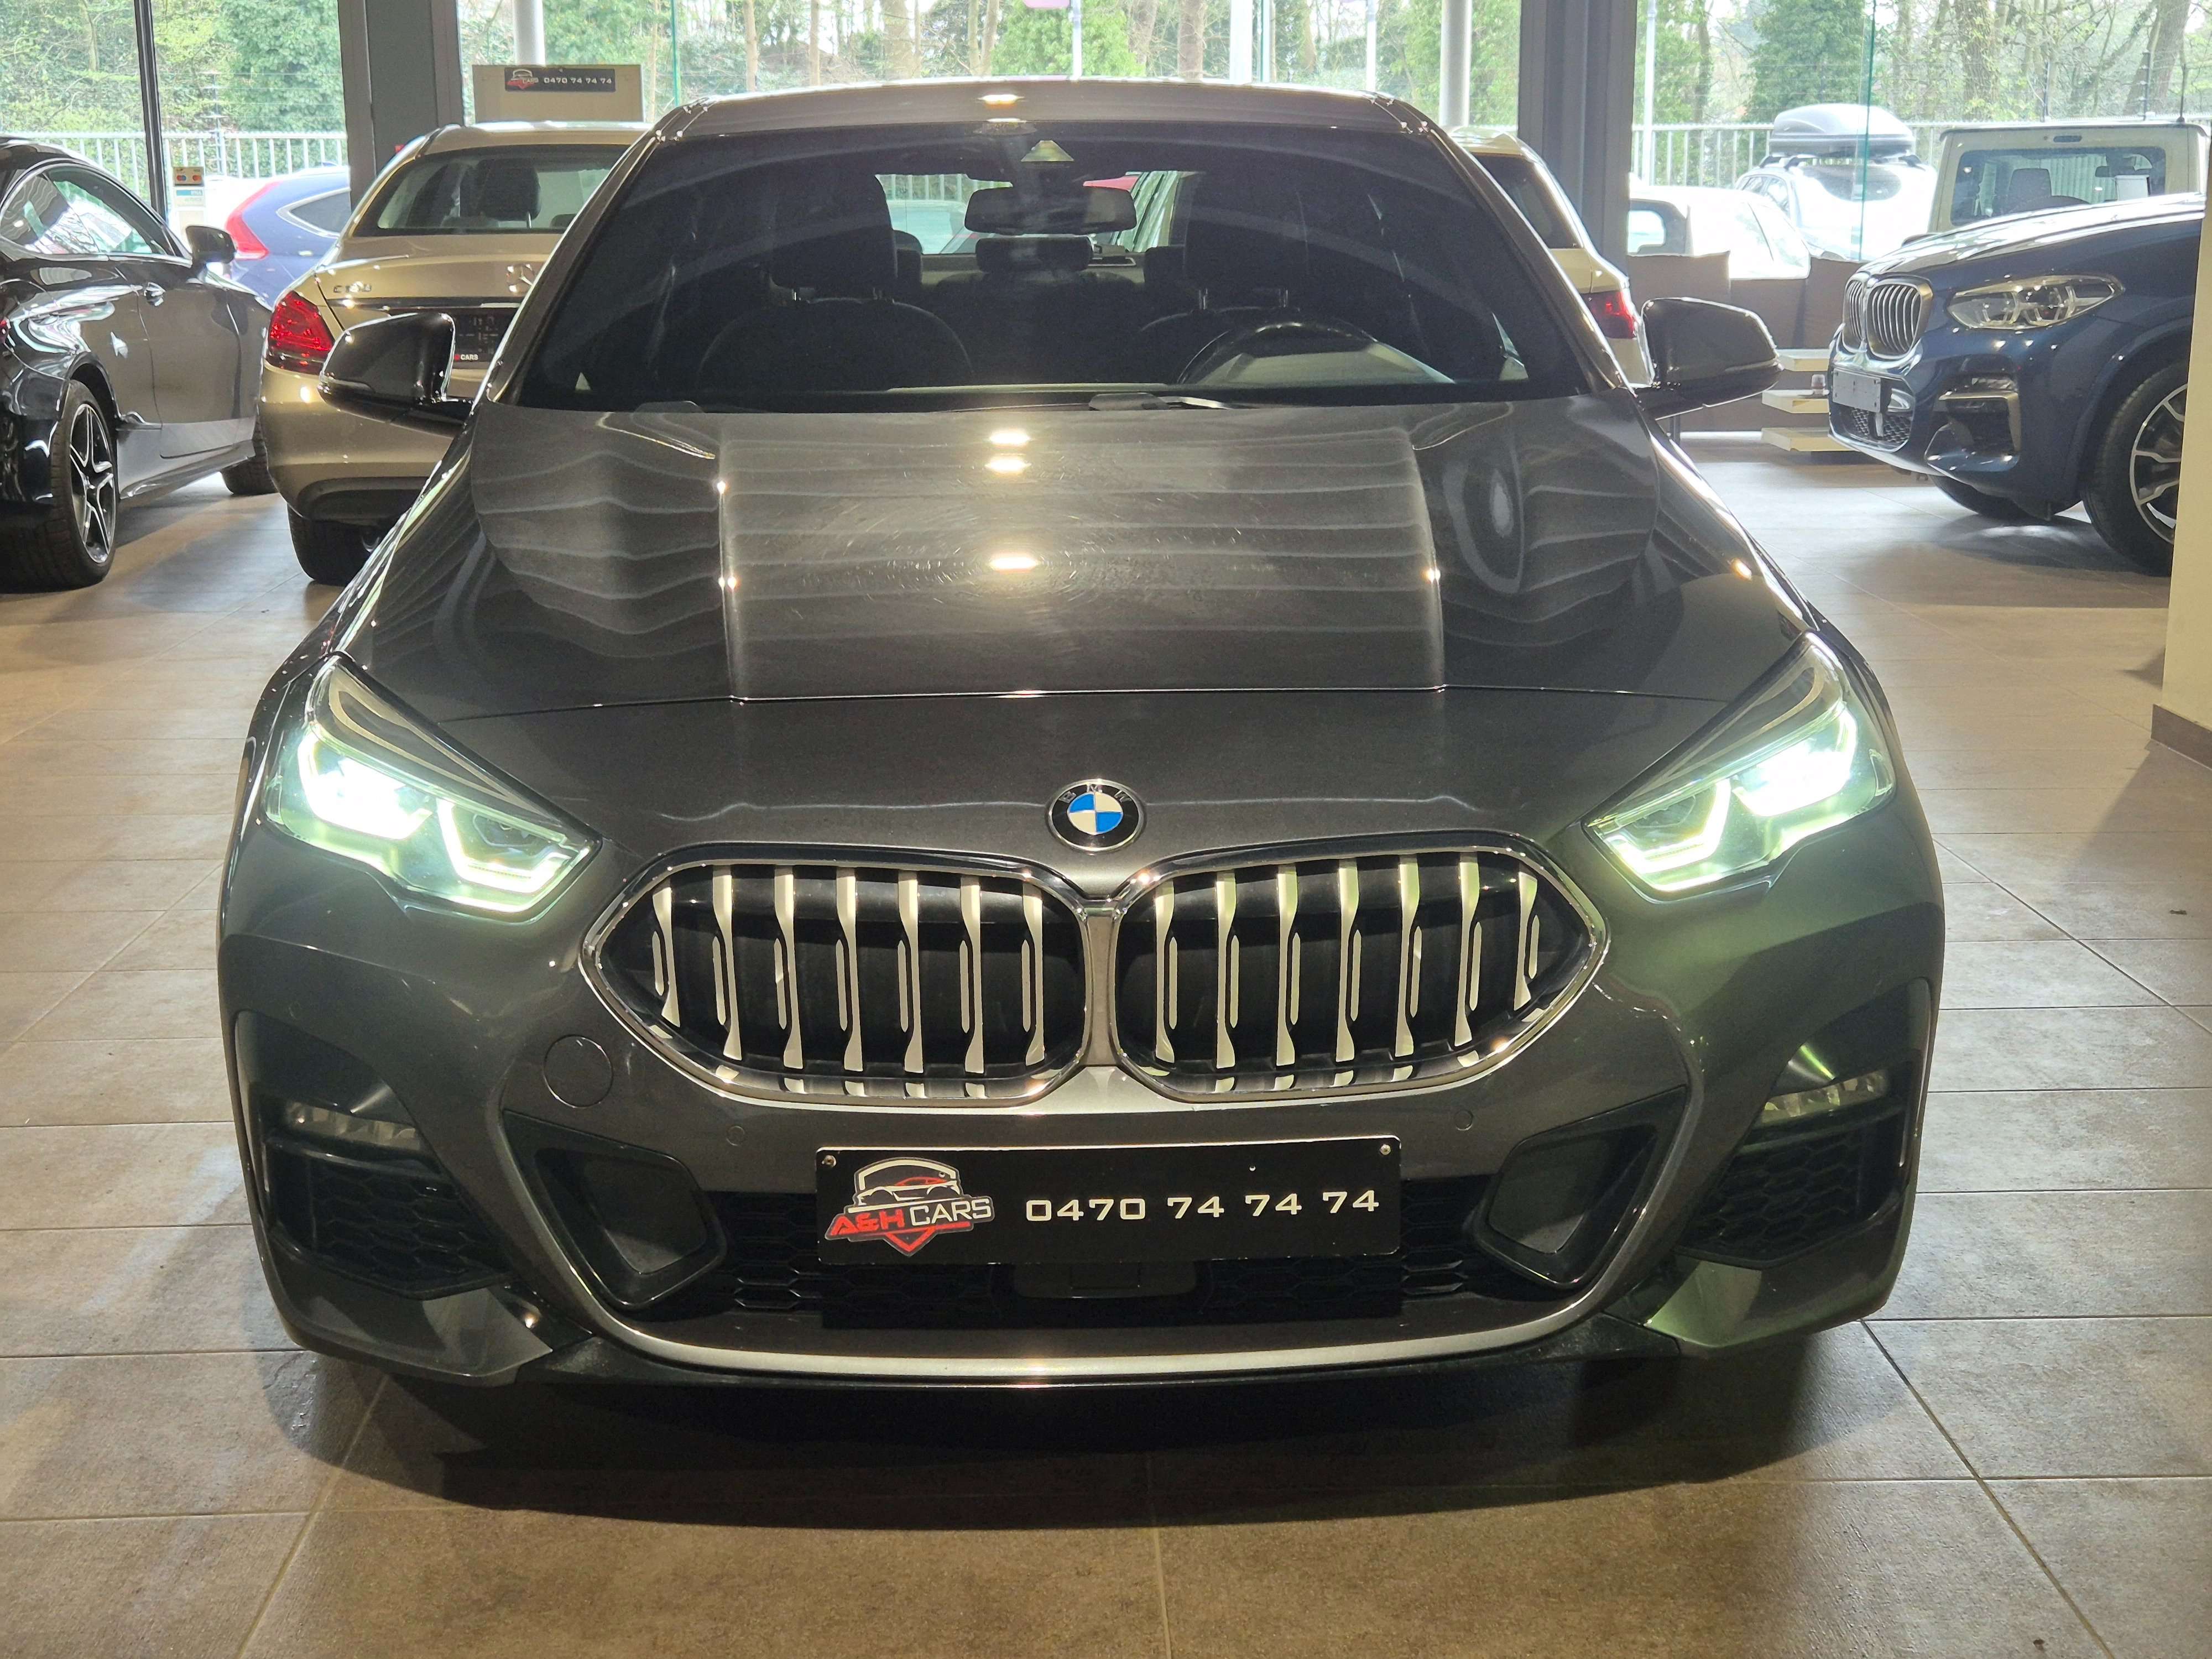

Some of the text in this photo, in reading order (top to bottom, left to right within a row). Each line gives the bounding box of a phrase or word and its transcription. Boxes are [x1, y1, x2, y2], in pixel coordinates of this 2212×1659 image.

[1058, 783, 1132, 804] BMW
[830, 1198, 992, 1236] A&H CARS
[1026, 1190, 1379, 1222] 0470 74 74 74
